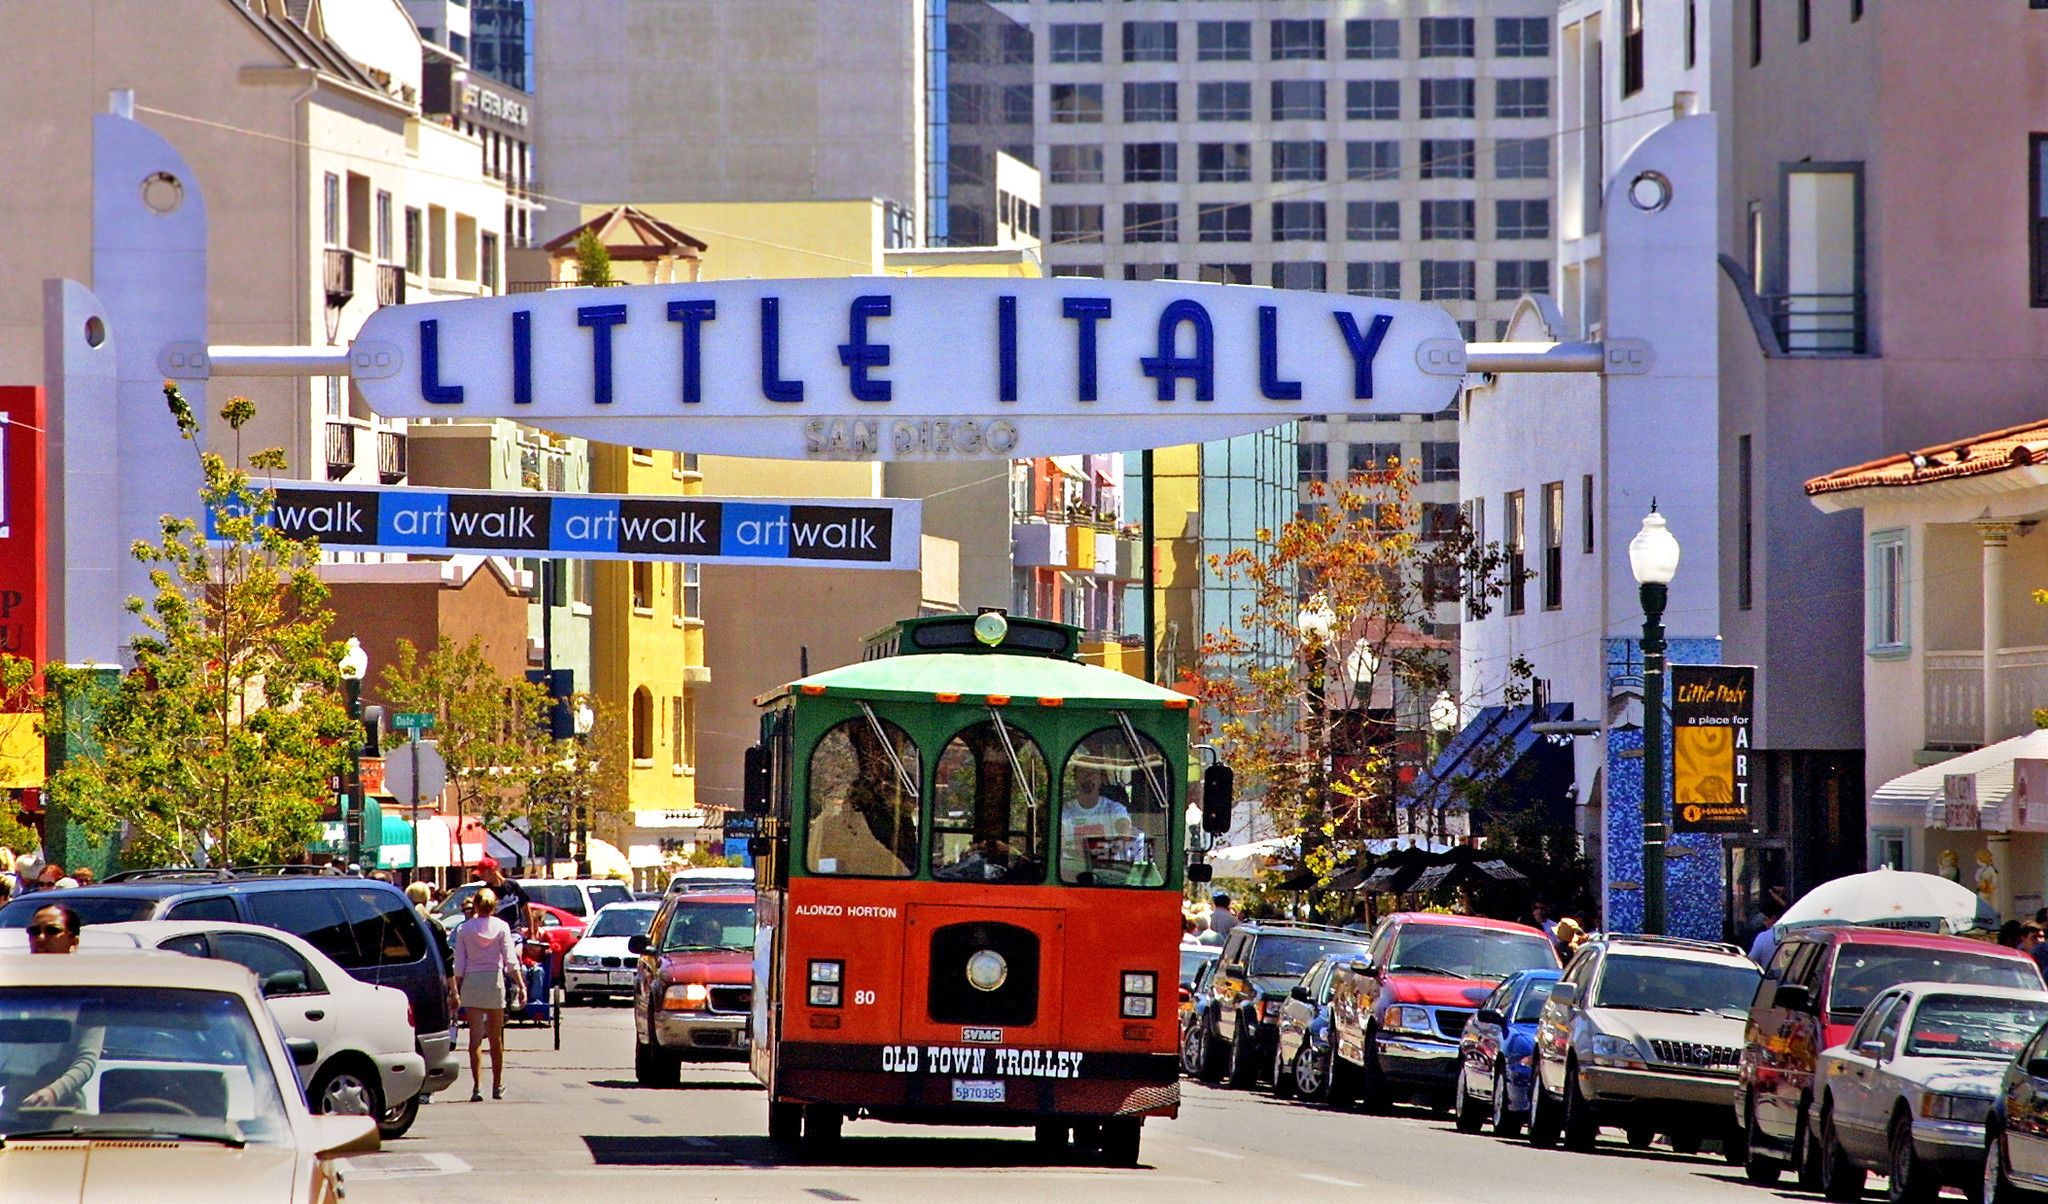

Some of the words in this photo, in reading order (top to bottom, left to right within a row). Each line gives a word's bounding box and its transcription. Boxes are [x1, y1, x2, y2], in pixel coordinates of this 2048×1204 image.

[419, 294, 892, 404] LITTLE
[997, 294, 1394, 402] ITALY
[805, 419, 878, 453] SAN
[891, 420, 1019, 454] DIEGO
[1698, 715, 1729, 725] place
[1733, 715, 1749, 725] for
[795, 904, 843, 916] ALONZO
[847, 905, 897, 918] HORTON
[854, 990, 875, 1005] 80
[963, 1029, 1001, 1041] SVMC
[882, 1046, 919, 1072] OLD
[927, 1046, 984, 1075] TOWN
[995, 1048, 1083, 1078] TROLLEY
